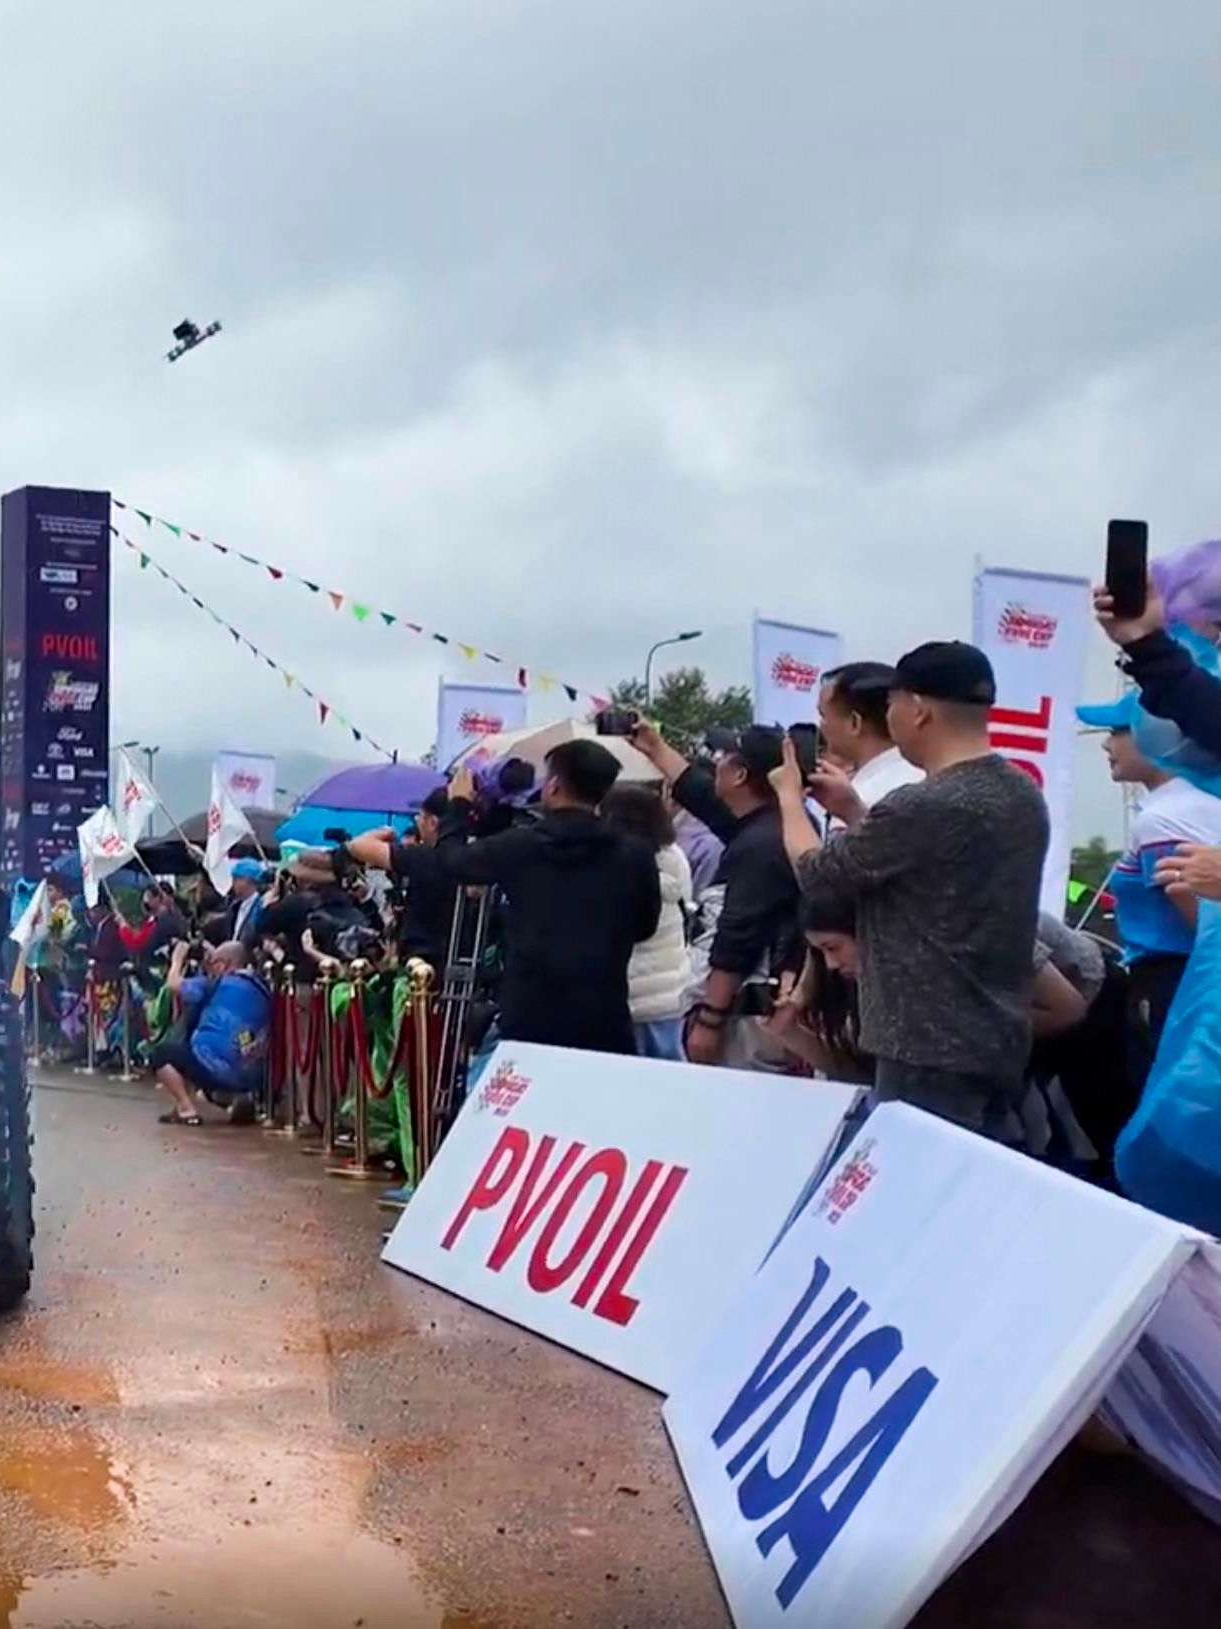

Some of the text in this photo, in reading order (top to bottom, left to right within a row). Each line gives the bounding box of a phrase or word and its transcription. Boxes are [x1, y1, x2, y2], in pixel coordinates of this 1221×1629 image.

[43, 634, 99, 660] PVOIL
[440, 1126, 689, 1327] PVOIL
[711, 1255, 940, 1612] VISA
